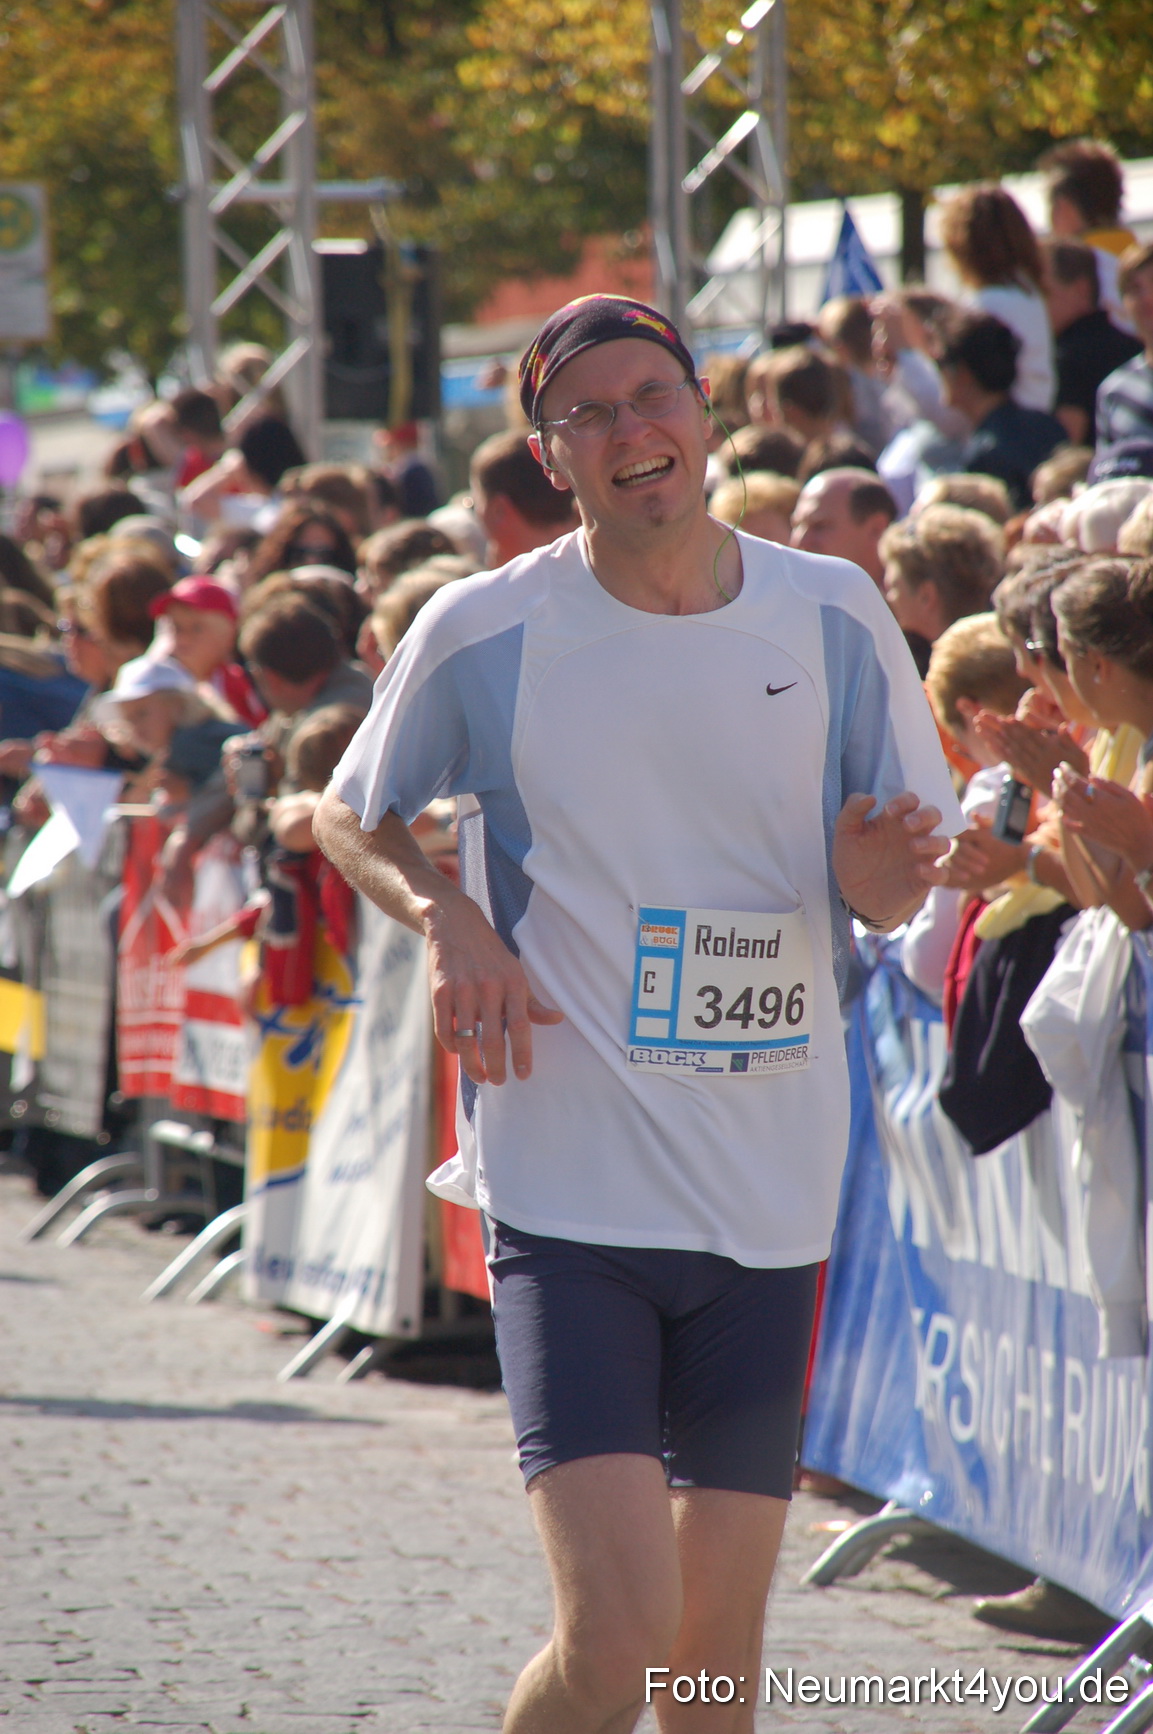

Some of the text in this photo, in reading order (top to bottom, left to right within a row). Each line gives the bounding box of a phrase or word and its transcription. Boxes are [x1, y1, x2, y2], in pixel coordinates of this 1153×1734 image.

[694, 924, 782, 959] Roland
[643, 970, 656, 994] C
[693, 982, 806, 1030] 3496
[630, 1047, 706, 1067] BOCK
[750, 1045, 809, 1065] PFLEIDERER
